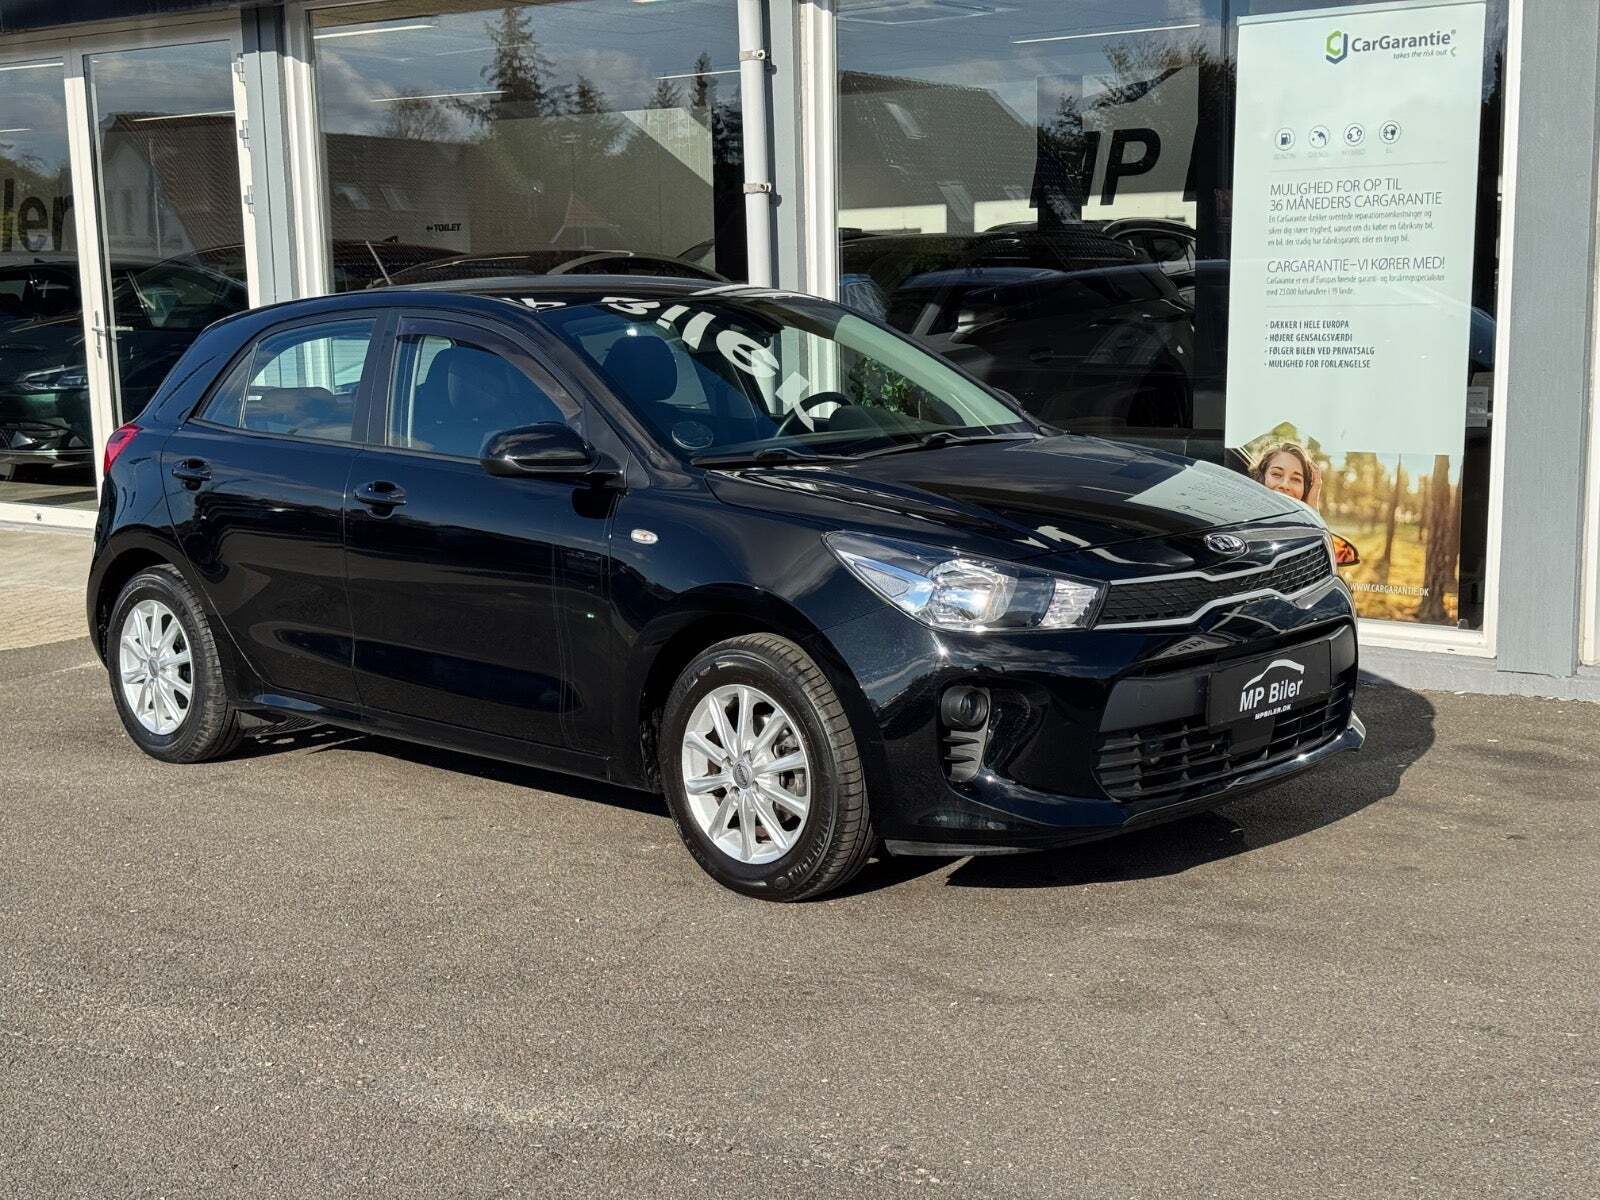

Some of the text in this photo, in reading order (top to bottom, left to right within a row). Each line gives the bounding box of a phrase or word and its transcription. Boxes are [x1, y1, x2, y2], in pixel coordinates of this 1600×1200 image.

[1270, 177, 1403, 196] MULIGHED FOR OP TIL
[1270, 191, 1442, 211] 36 MÅNEDERS CARGARANTIE
[434, 223, 461, 232] TOILET
[1371, 257, 1410, 271] KØRER
[1412, 256, 1445, 269] MED!
[1270, 320, 1298, 329] DÆKKER
[1303, 320, 1320, 328] HELE
[1322, 319, 1349, 328] EUROPA
[1269, 333, 1353, 342] HØJERE GENSALGSVÆRDI
[1269, 346, 1375, 355] FØLGER BILEN VED PRIVATSALG
[1268, 359, 1371, 369] MULIGHED FOR FORLÆNGELSE
[1239, 679, 1304, 713] MP Biler
